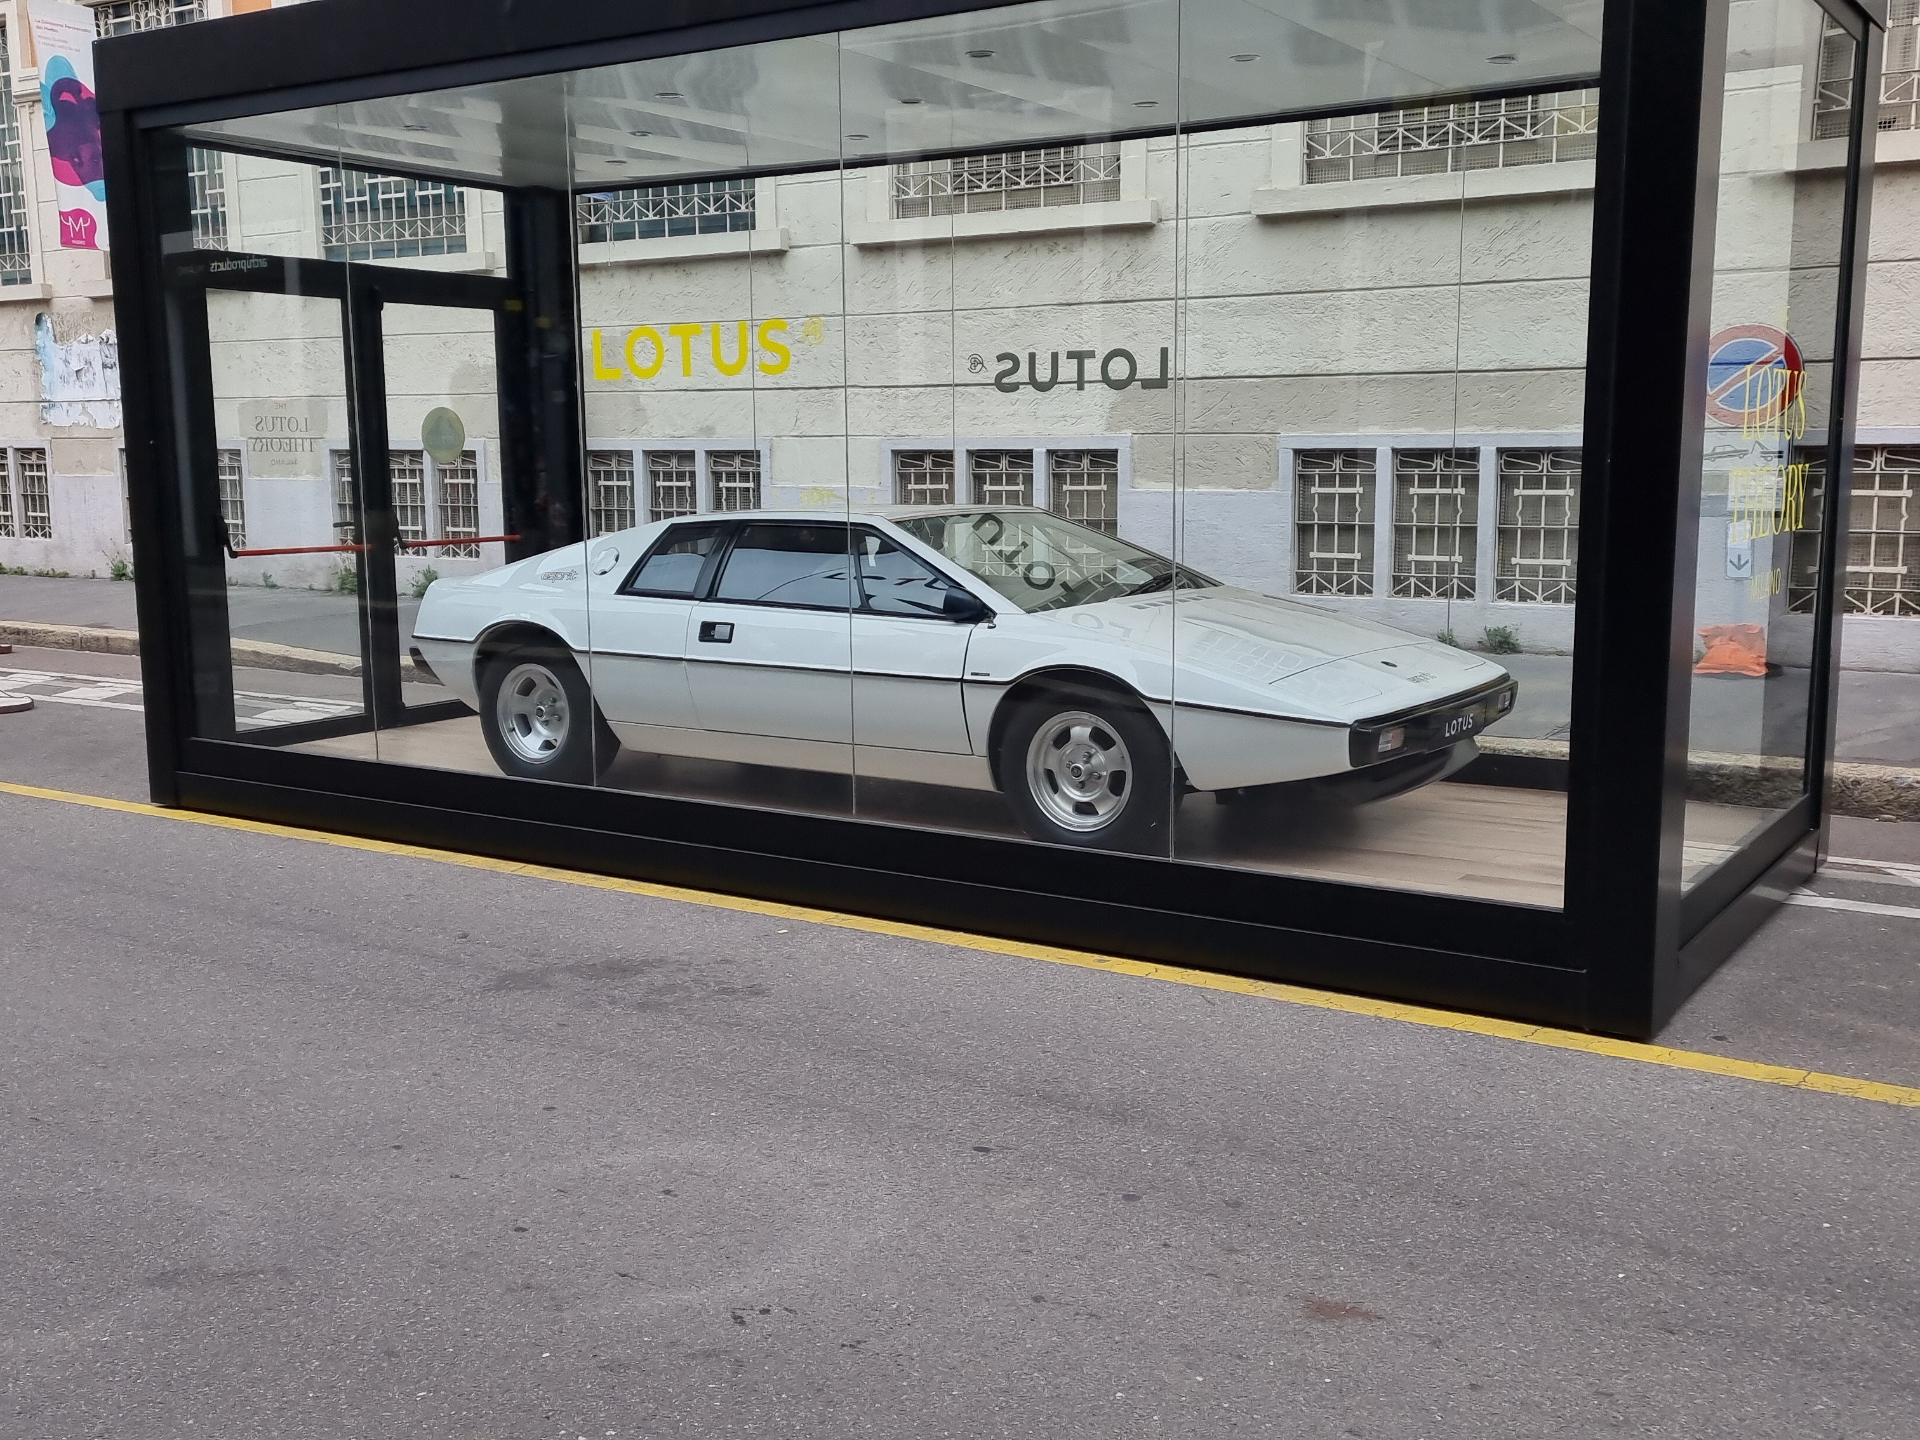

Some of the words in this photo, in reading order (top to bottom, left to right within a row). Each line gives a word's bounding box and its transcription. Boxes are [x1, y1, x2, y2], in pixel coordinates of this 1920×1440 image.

[591, 317, 792, 381] LOTUS
[1743, 365, 1808, 440] LOTUS
[1730, 463, 1810, 543] THEORY
[1444, 713, 1474, 738] LOTUS
